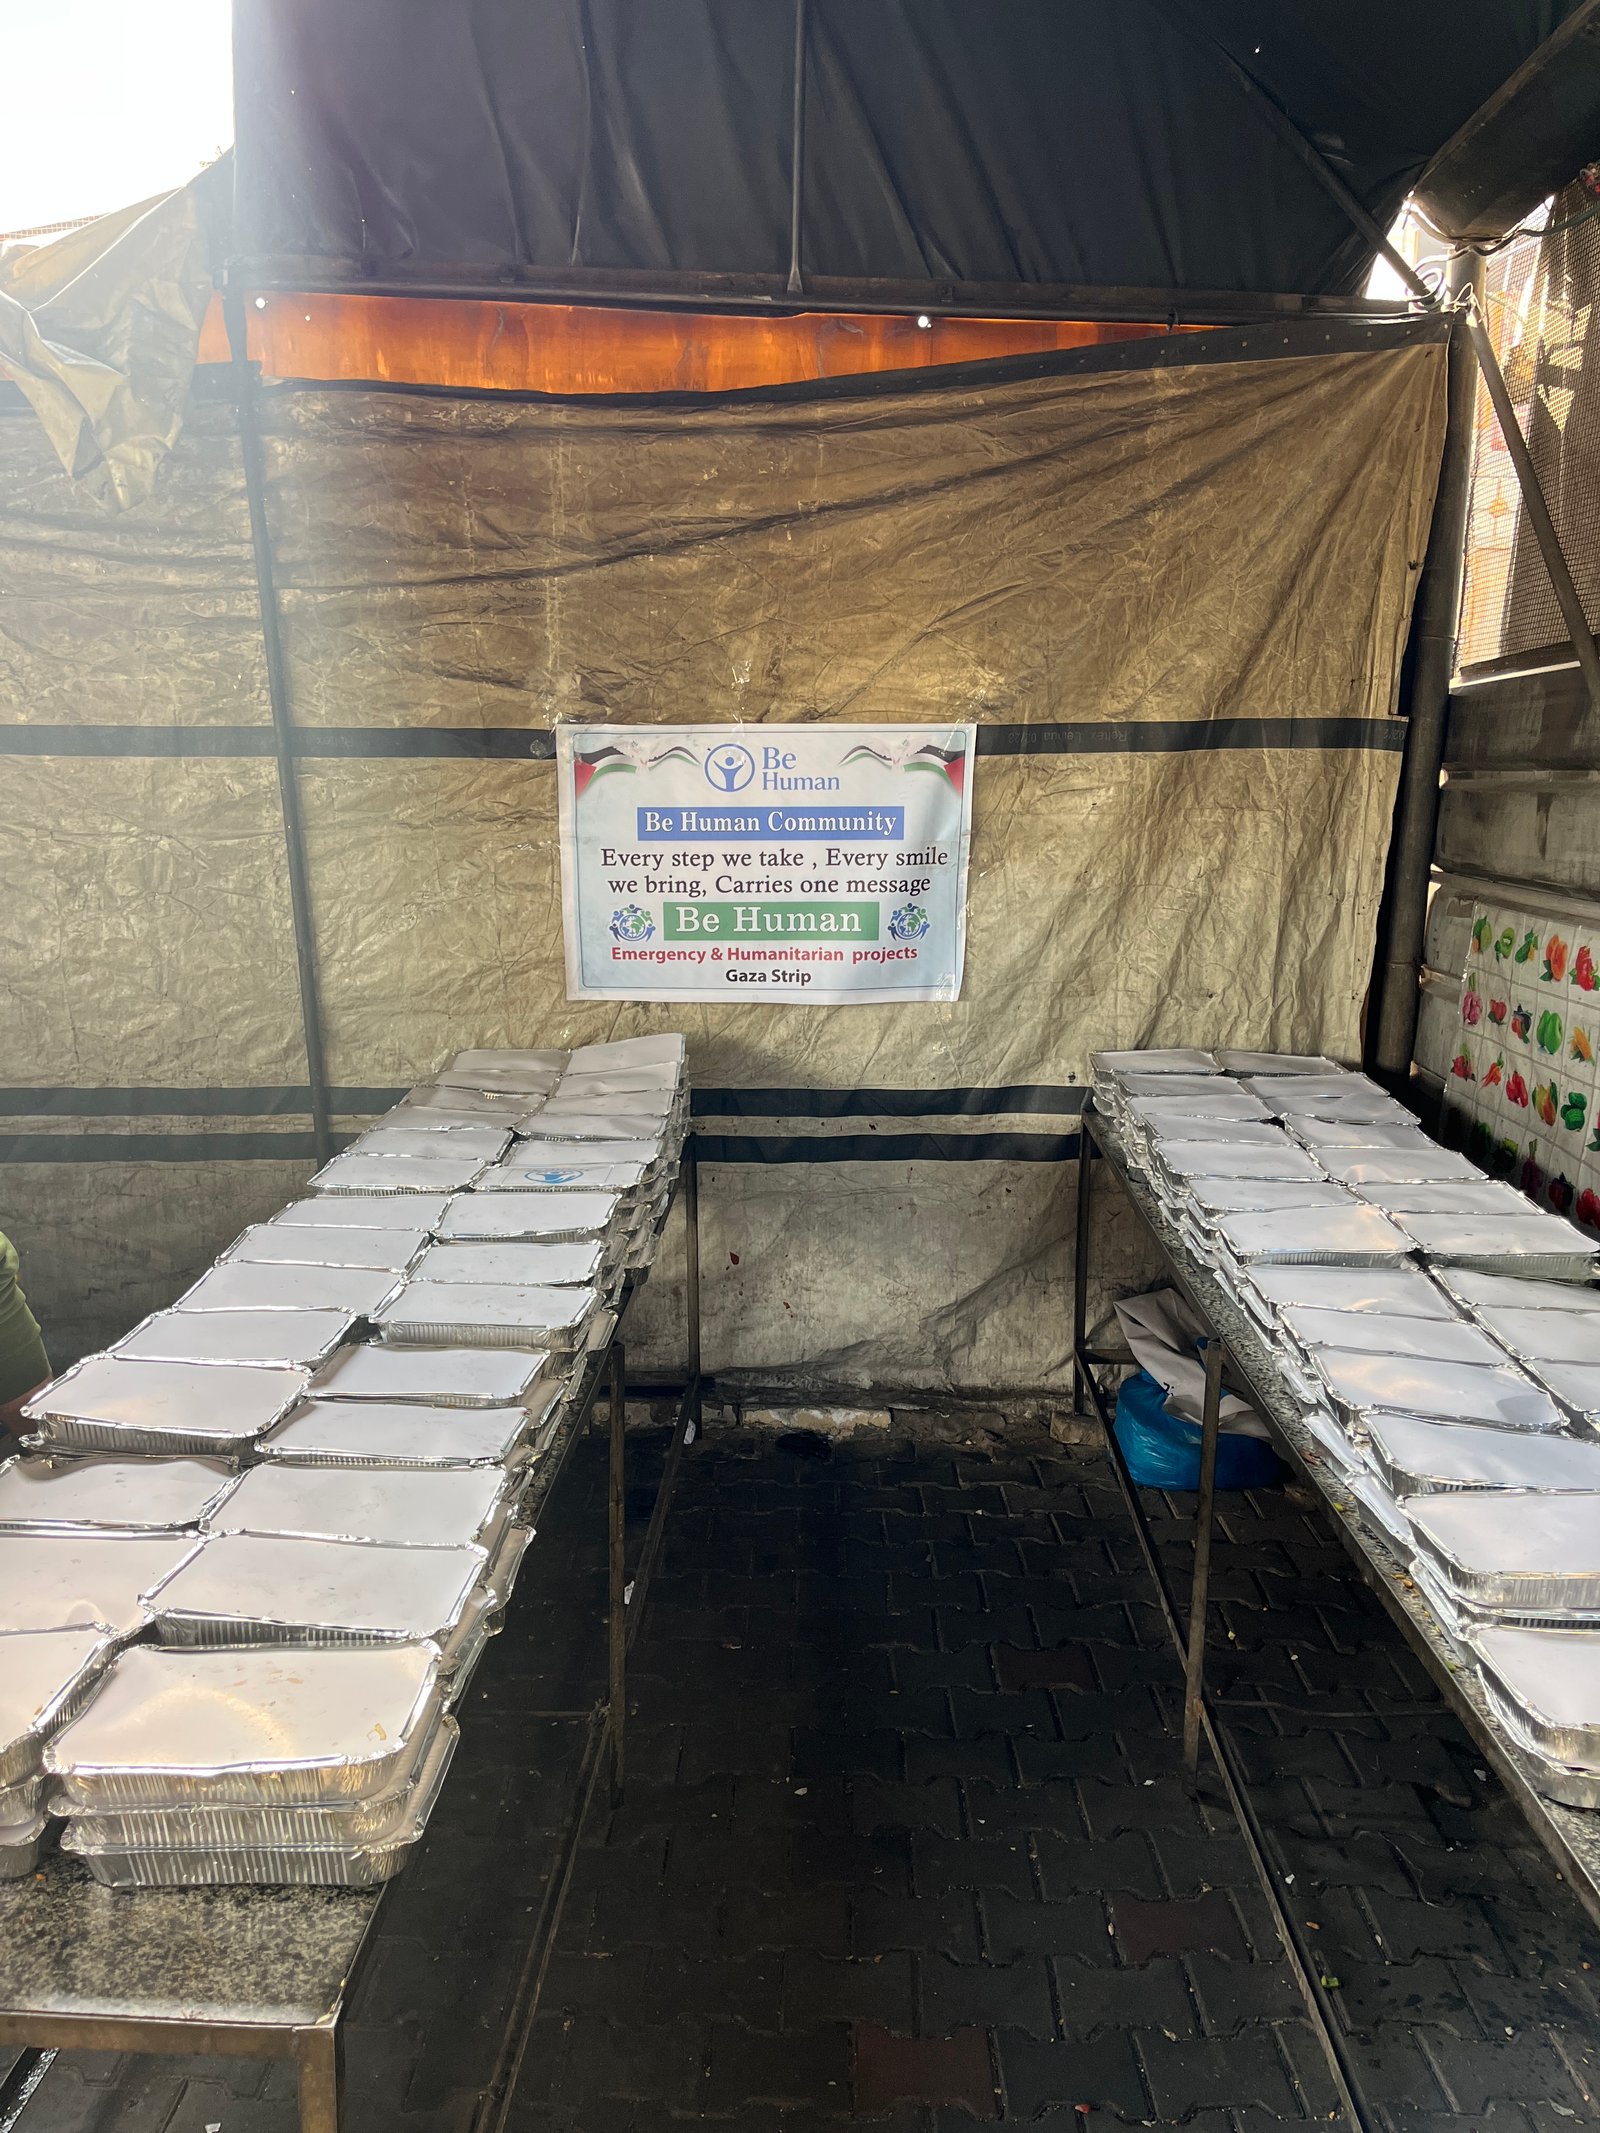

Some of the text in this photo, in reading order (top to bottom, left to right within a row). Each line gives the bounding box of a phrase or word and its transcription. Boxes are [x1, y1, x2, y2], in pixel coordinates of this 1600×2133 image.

[762, 748, 797, 770] Be
[762, 773, 840, 791] Human
[645, 811, 896, 836] Be Human Community
[600, 848, 664, 871] Every
[672, 850, 715, 871] step
[722, 853, 752, 867] we
[759, 848, 803, 867] take
[825, 848, 889, 871] Every
[895, 846, 948, 867] smile
[608, 875, 931, 898] we bring, Carries one message
[676, 906, 862, 933] Be Human
[611, 946, 918, 964] Emergency & Humanitarian projects
[725, 969, 811, 986] Gaza Strip
